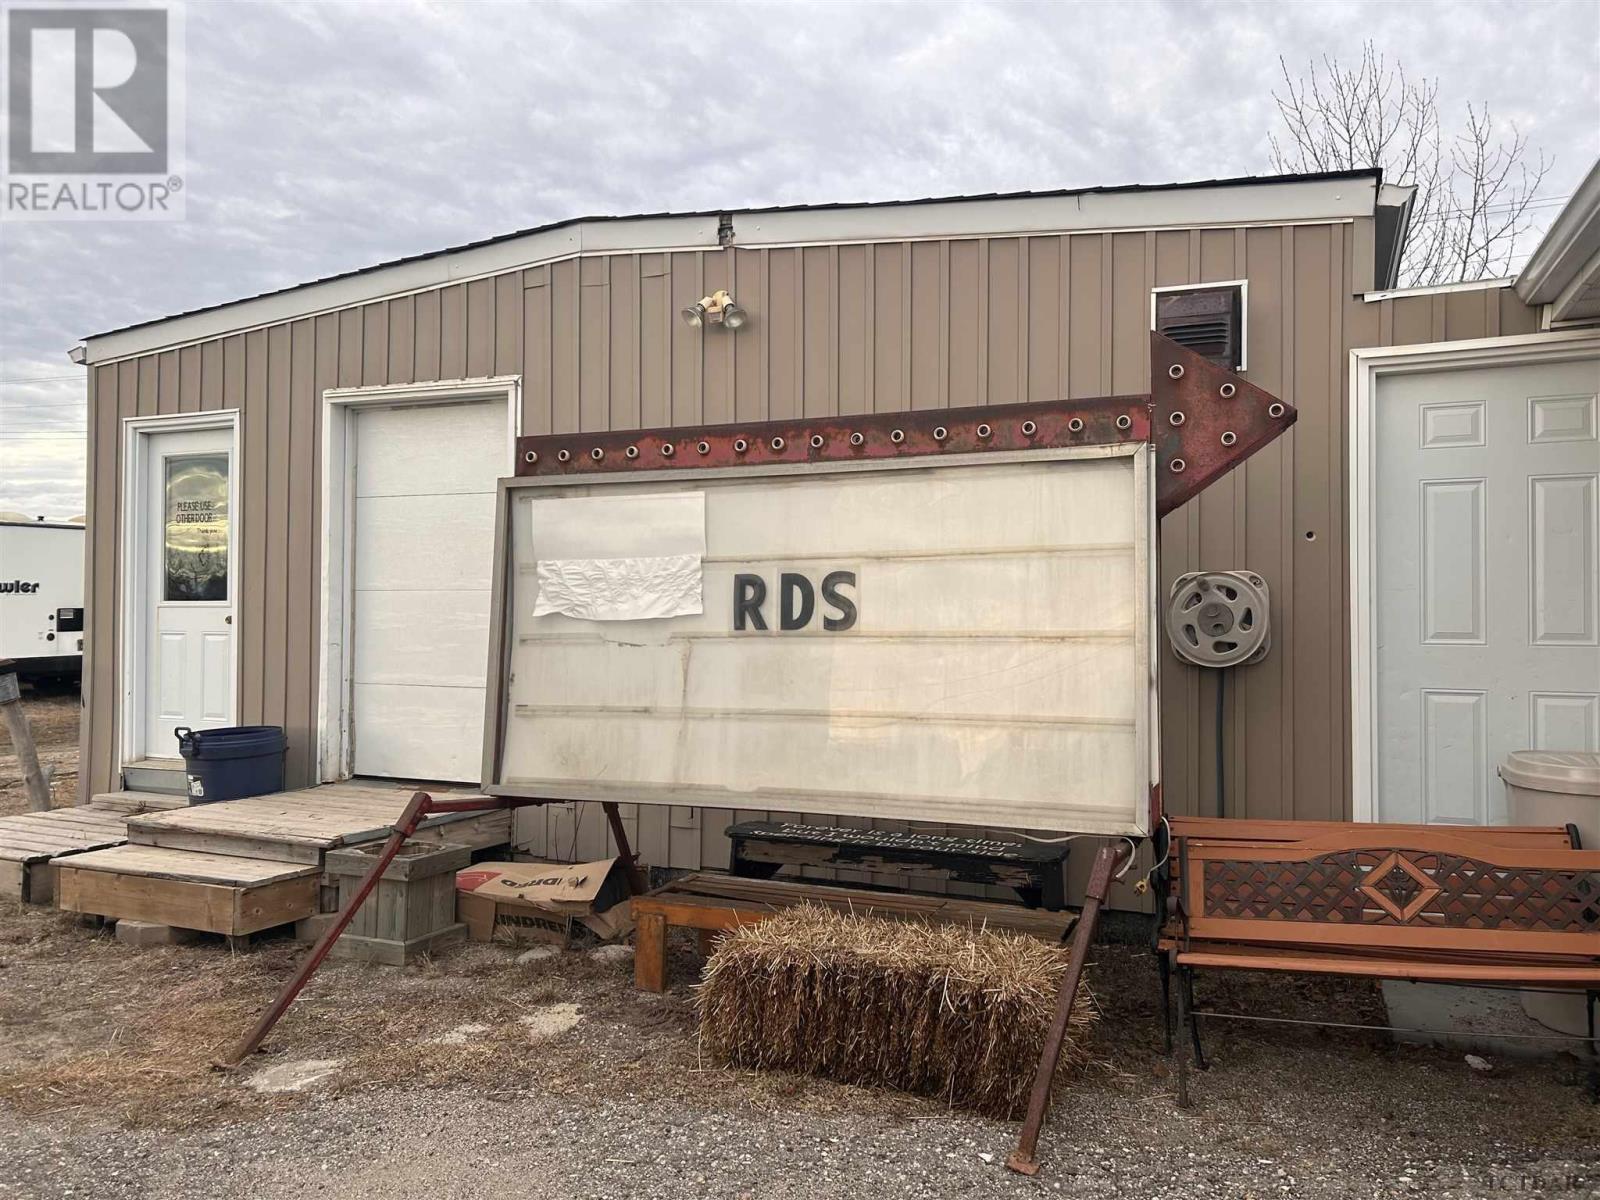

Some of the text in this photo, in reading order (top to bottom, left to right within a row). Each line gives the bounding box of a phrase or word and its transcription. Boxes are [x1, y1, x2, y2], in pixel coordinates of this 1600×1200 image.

[177, 500, 212, 511] PLEASE USE
[176, 513, 195, 523] OTHER
[733, 570, 858, 631] RDS
[780, 822, 863, 834] Forever
[910, 833, 959, 842] long
[947, 843, 1006, 852] mind
